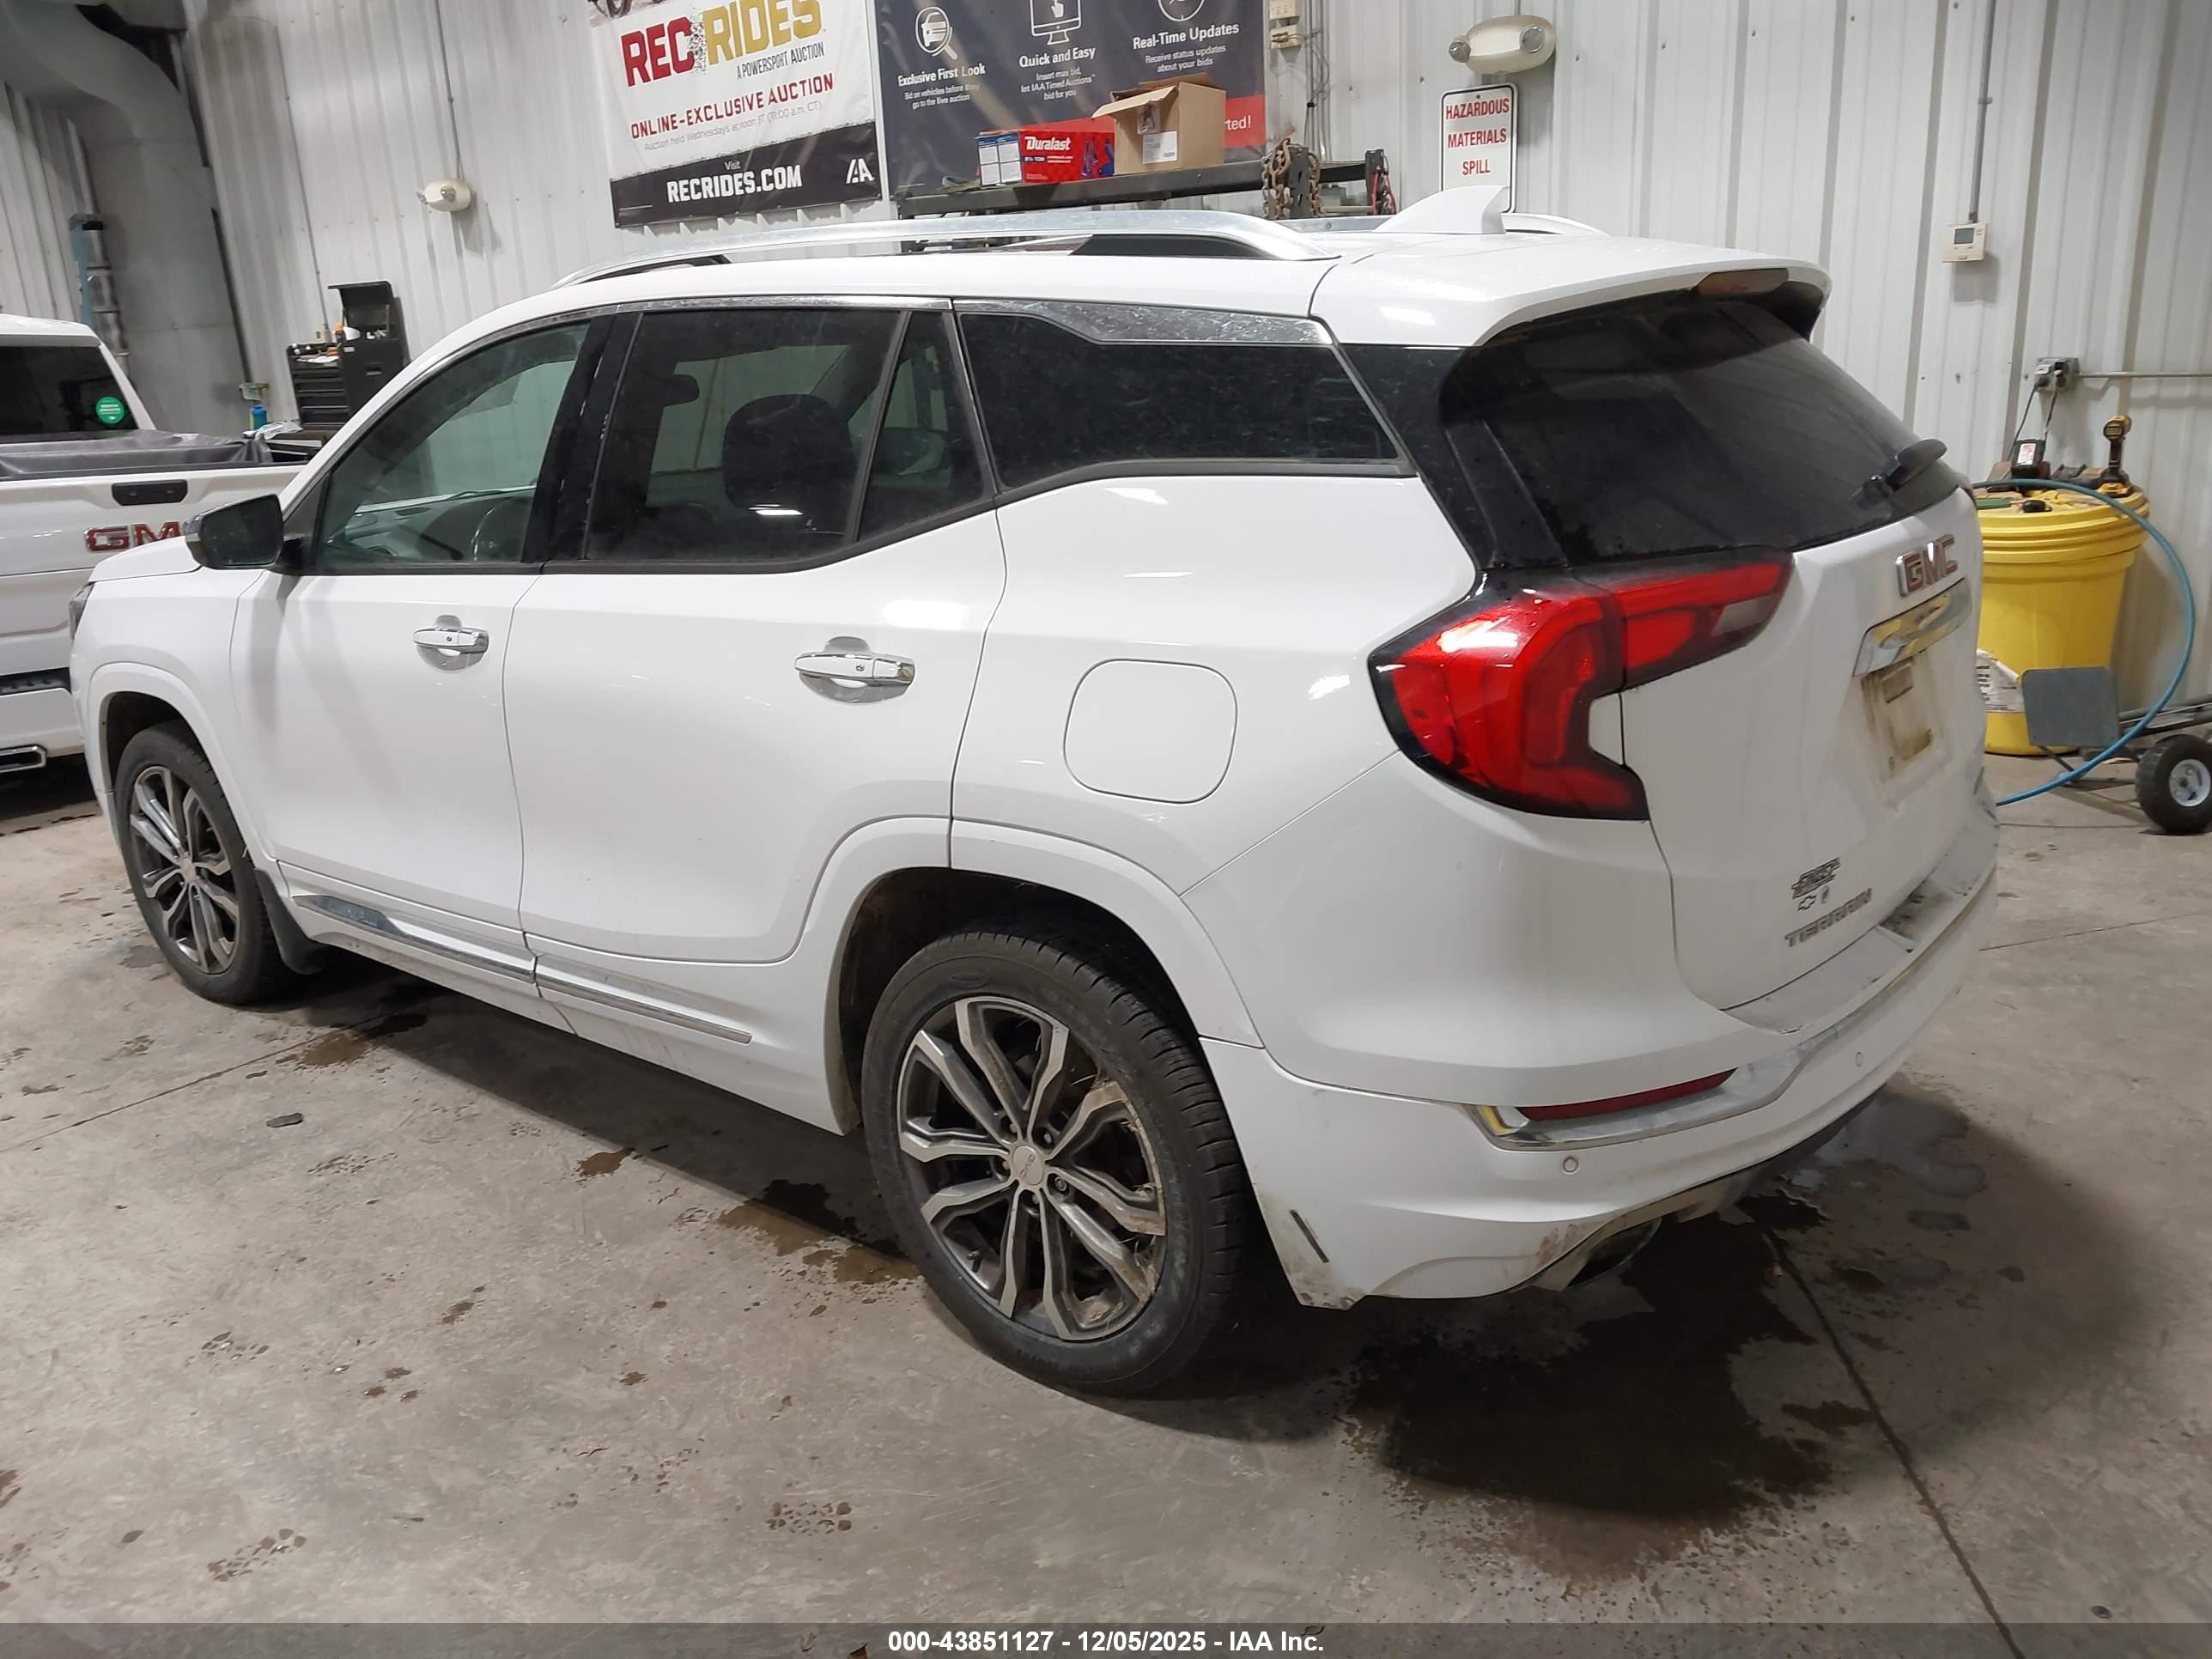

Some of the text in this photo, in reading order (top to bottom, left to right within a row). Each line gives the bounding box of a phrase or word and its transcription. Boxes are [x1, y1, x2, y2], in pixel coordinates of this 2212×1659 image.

[1133, 23, 1239, 50] Real-Time Updates
[621, 16, 695, 87] REC
[737, 41, 825, 79] A POWERSPORT AUCTION
[1019, 46, 1096, 68] Quick and Easy
[897, 63, 986, 87] Exclusive First Look
[1157, 63, 1177, 72] about
[631, 73, 833, 139] ONLINE-EXCLUSIVE AUCTION
[1445, 98, 1510, 119] HAZARDOUS
[1024, 136, 1072, 151] Duralast
[1448, 128, 1506, 149] MATERIALS
[724, 160, 742, 170] Visit
[1462, 159, 1491, 175] SPILL
[666, 164, 803, 204] RECRIDES.COM
[83, 520, 181, 551] GM
[1896, 534, 1958, 597] GMC
